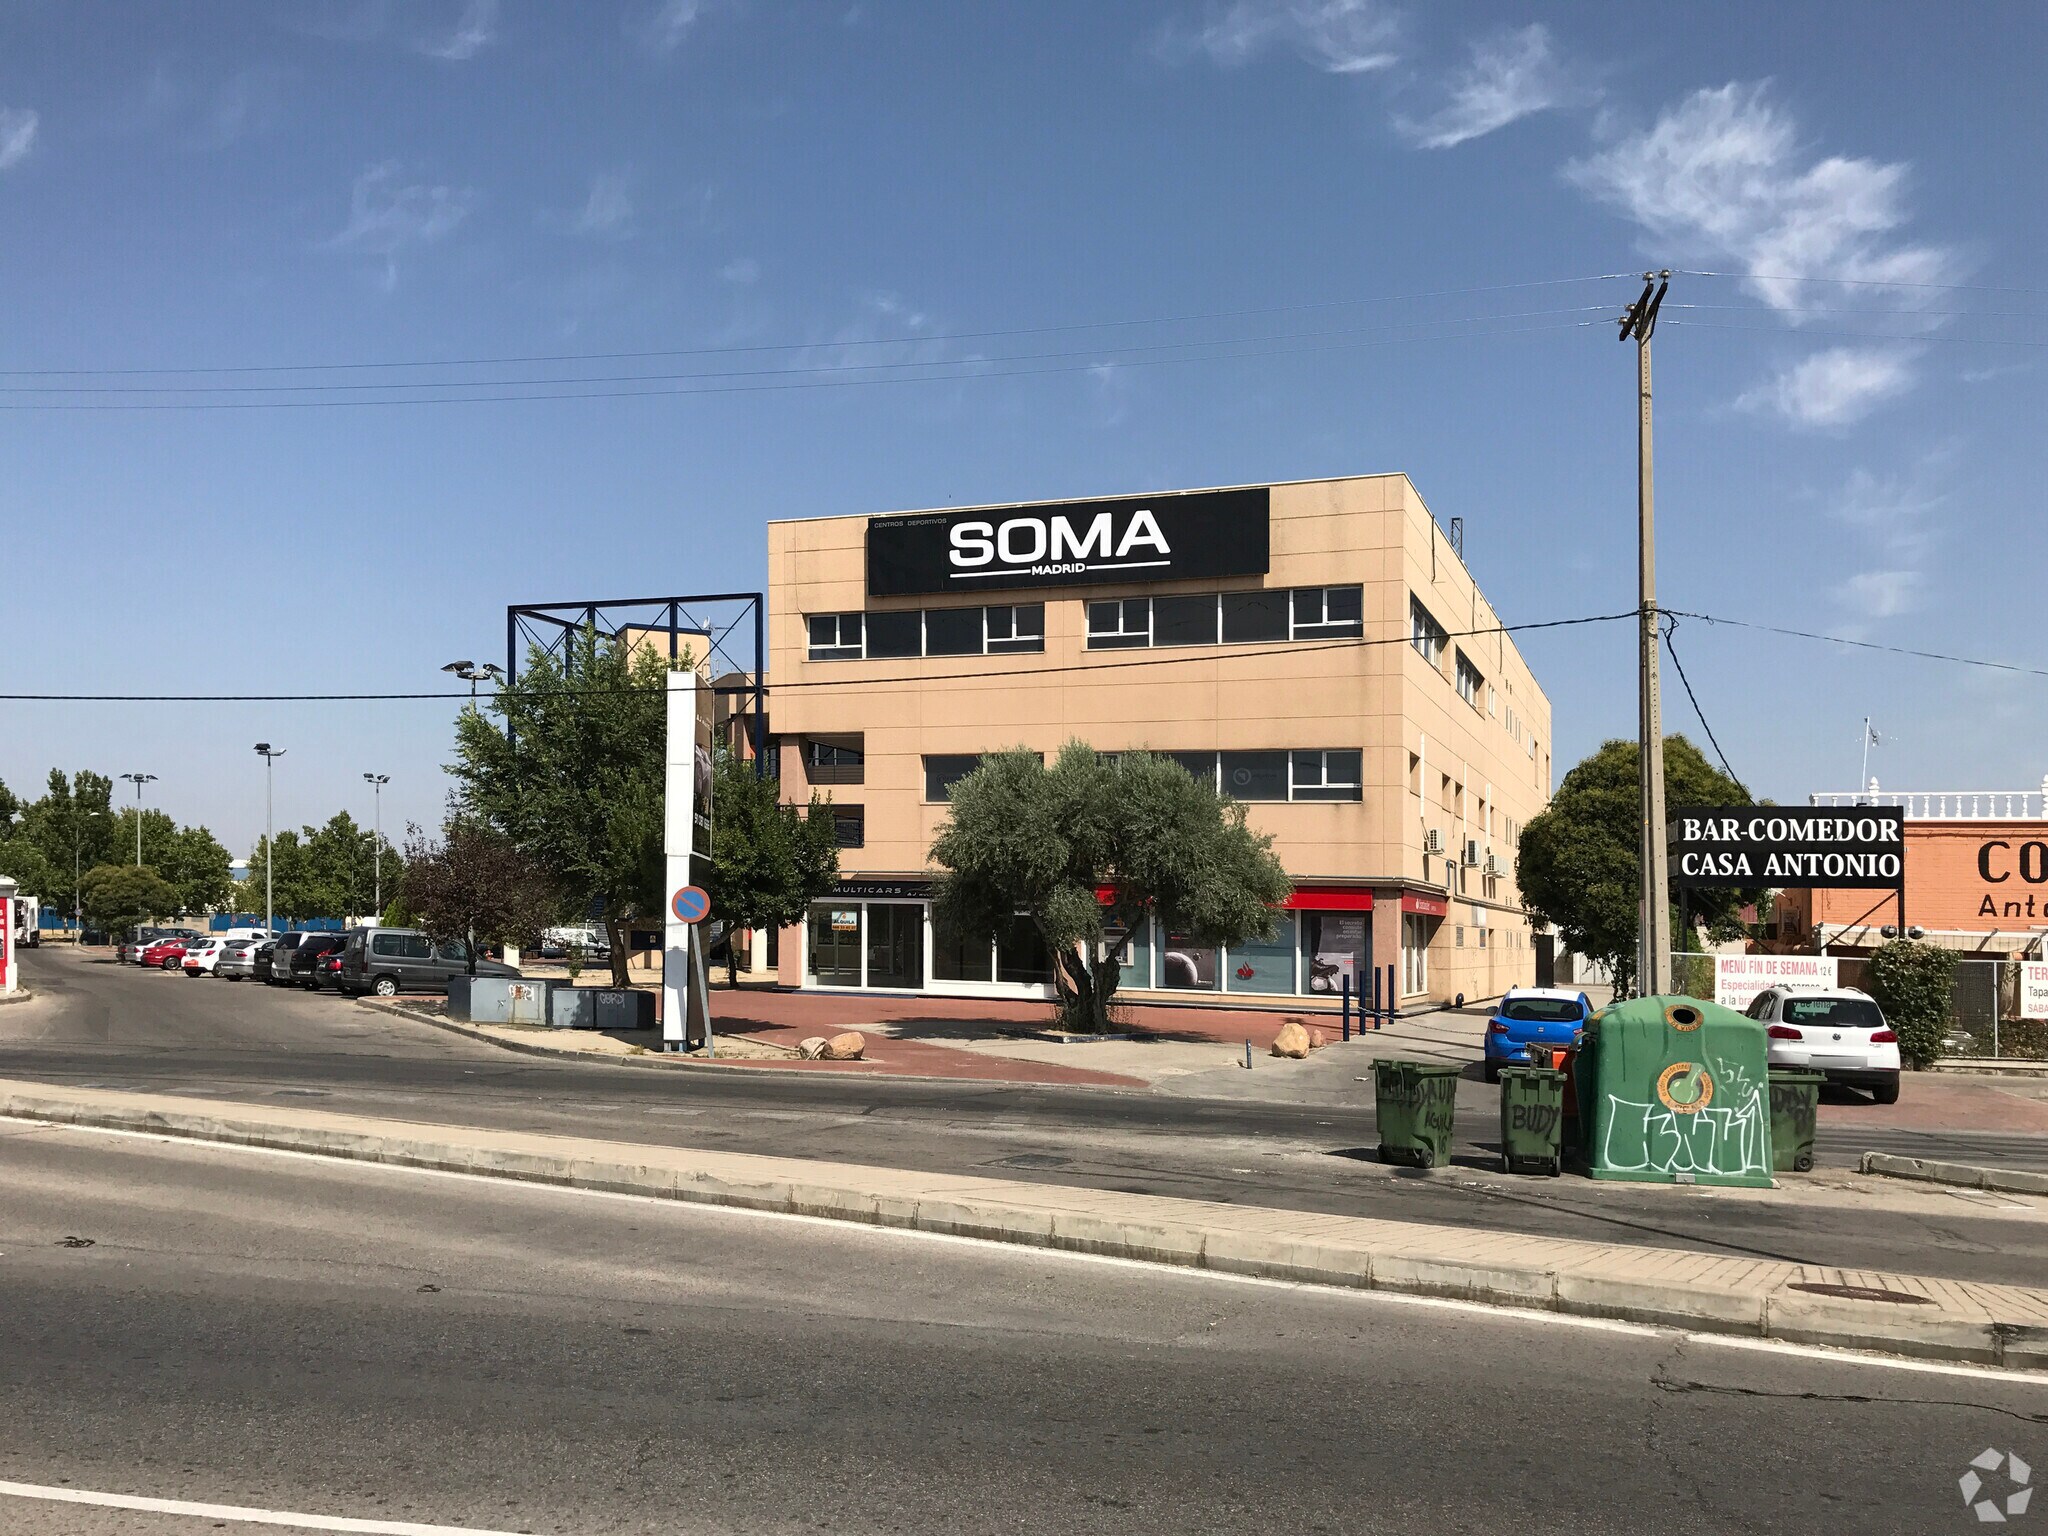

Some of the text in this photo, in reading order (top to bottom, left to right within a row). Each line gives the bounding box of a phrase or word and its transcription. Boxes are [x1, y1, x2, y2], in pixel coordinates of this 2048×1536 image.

[874, 517, 948, 529] CENTROS DEPORTIVOS
[949, 509, 1171, 567] SOMA
[1031, 562, 1086, 576] MADRID
[1682, 818, 1900, 842] BAR-COMEDOR
[1681, 852, 1901, 878] CASA ANTONIO
[832, 886, 902, 894] MULTICARS
[1721, 957, 1746, 974] MENÚ
[1766, 961, 1778, 975] DE
[1780, 961, 1818, 976] SEMANA
[2028, 967, 2048, 980] TER
[1721, 978, 1775, 992] Especialidad
[1721, 994, 1753, 1005] a la bra
[1512, 1104, 1561, 1141] BUDY
